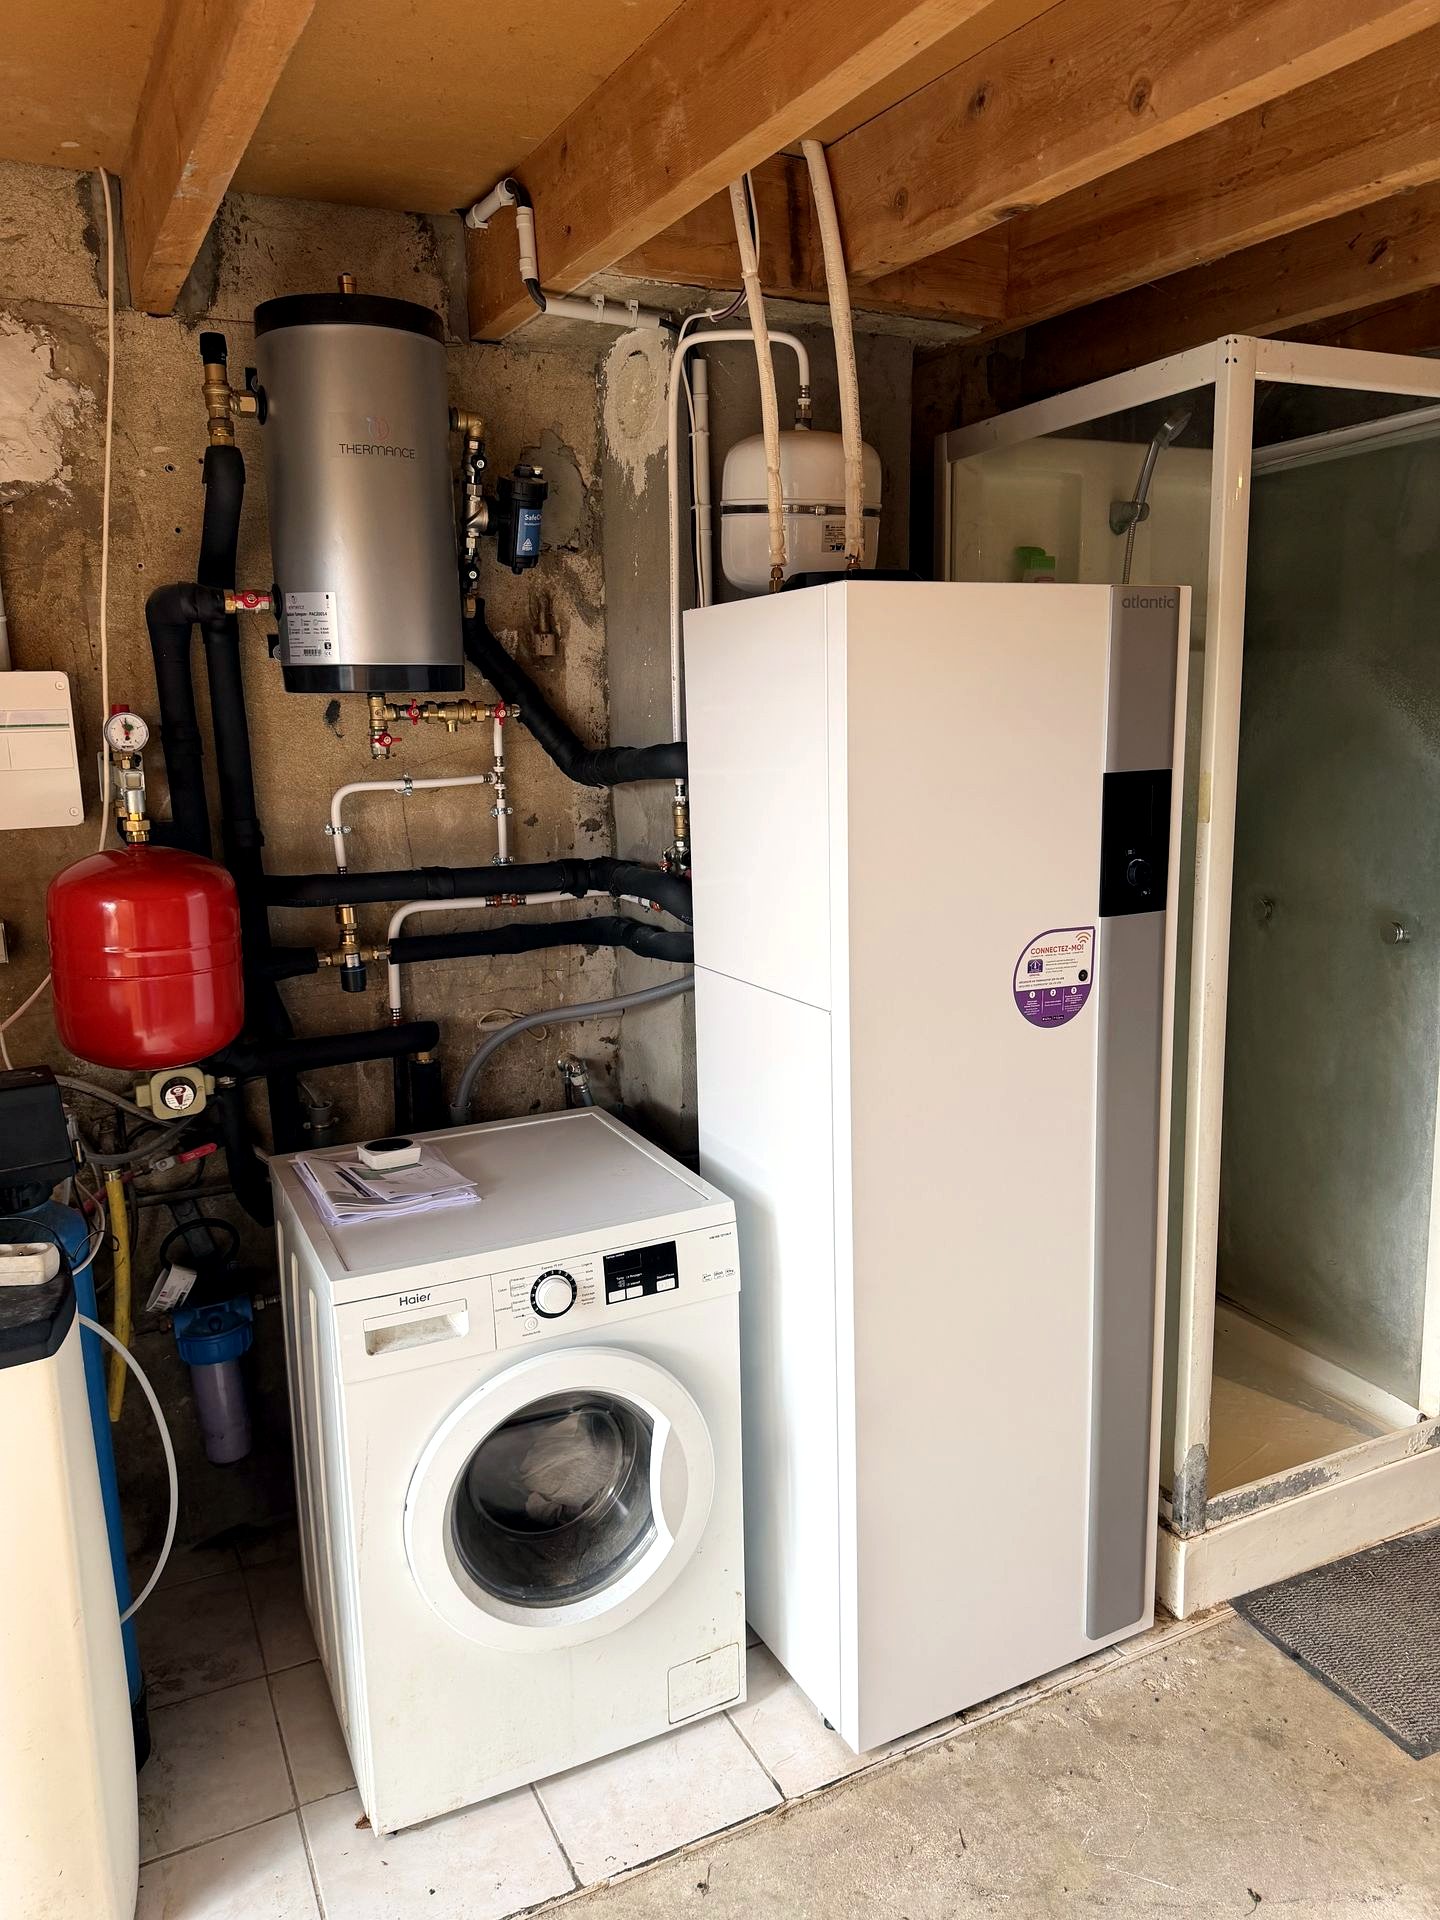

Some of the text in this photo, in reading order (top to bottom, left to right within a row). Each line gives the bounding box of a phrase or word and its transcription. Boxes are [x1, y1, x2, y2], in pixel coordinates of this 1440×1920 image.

[338, 443, 416, 459] THERMANCE
[1121, 594, 1175, 609] atlantic
[399, 1292, 431, 1306] Haier
